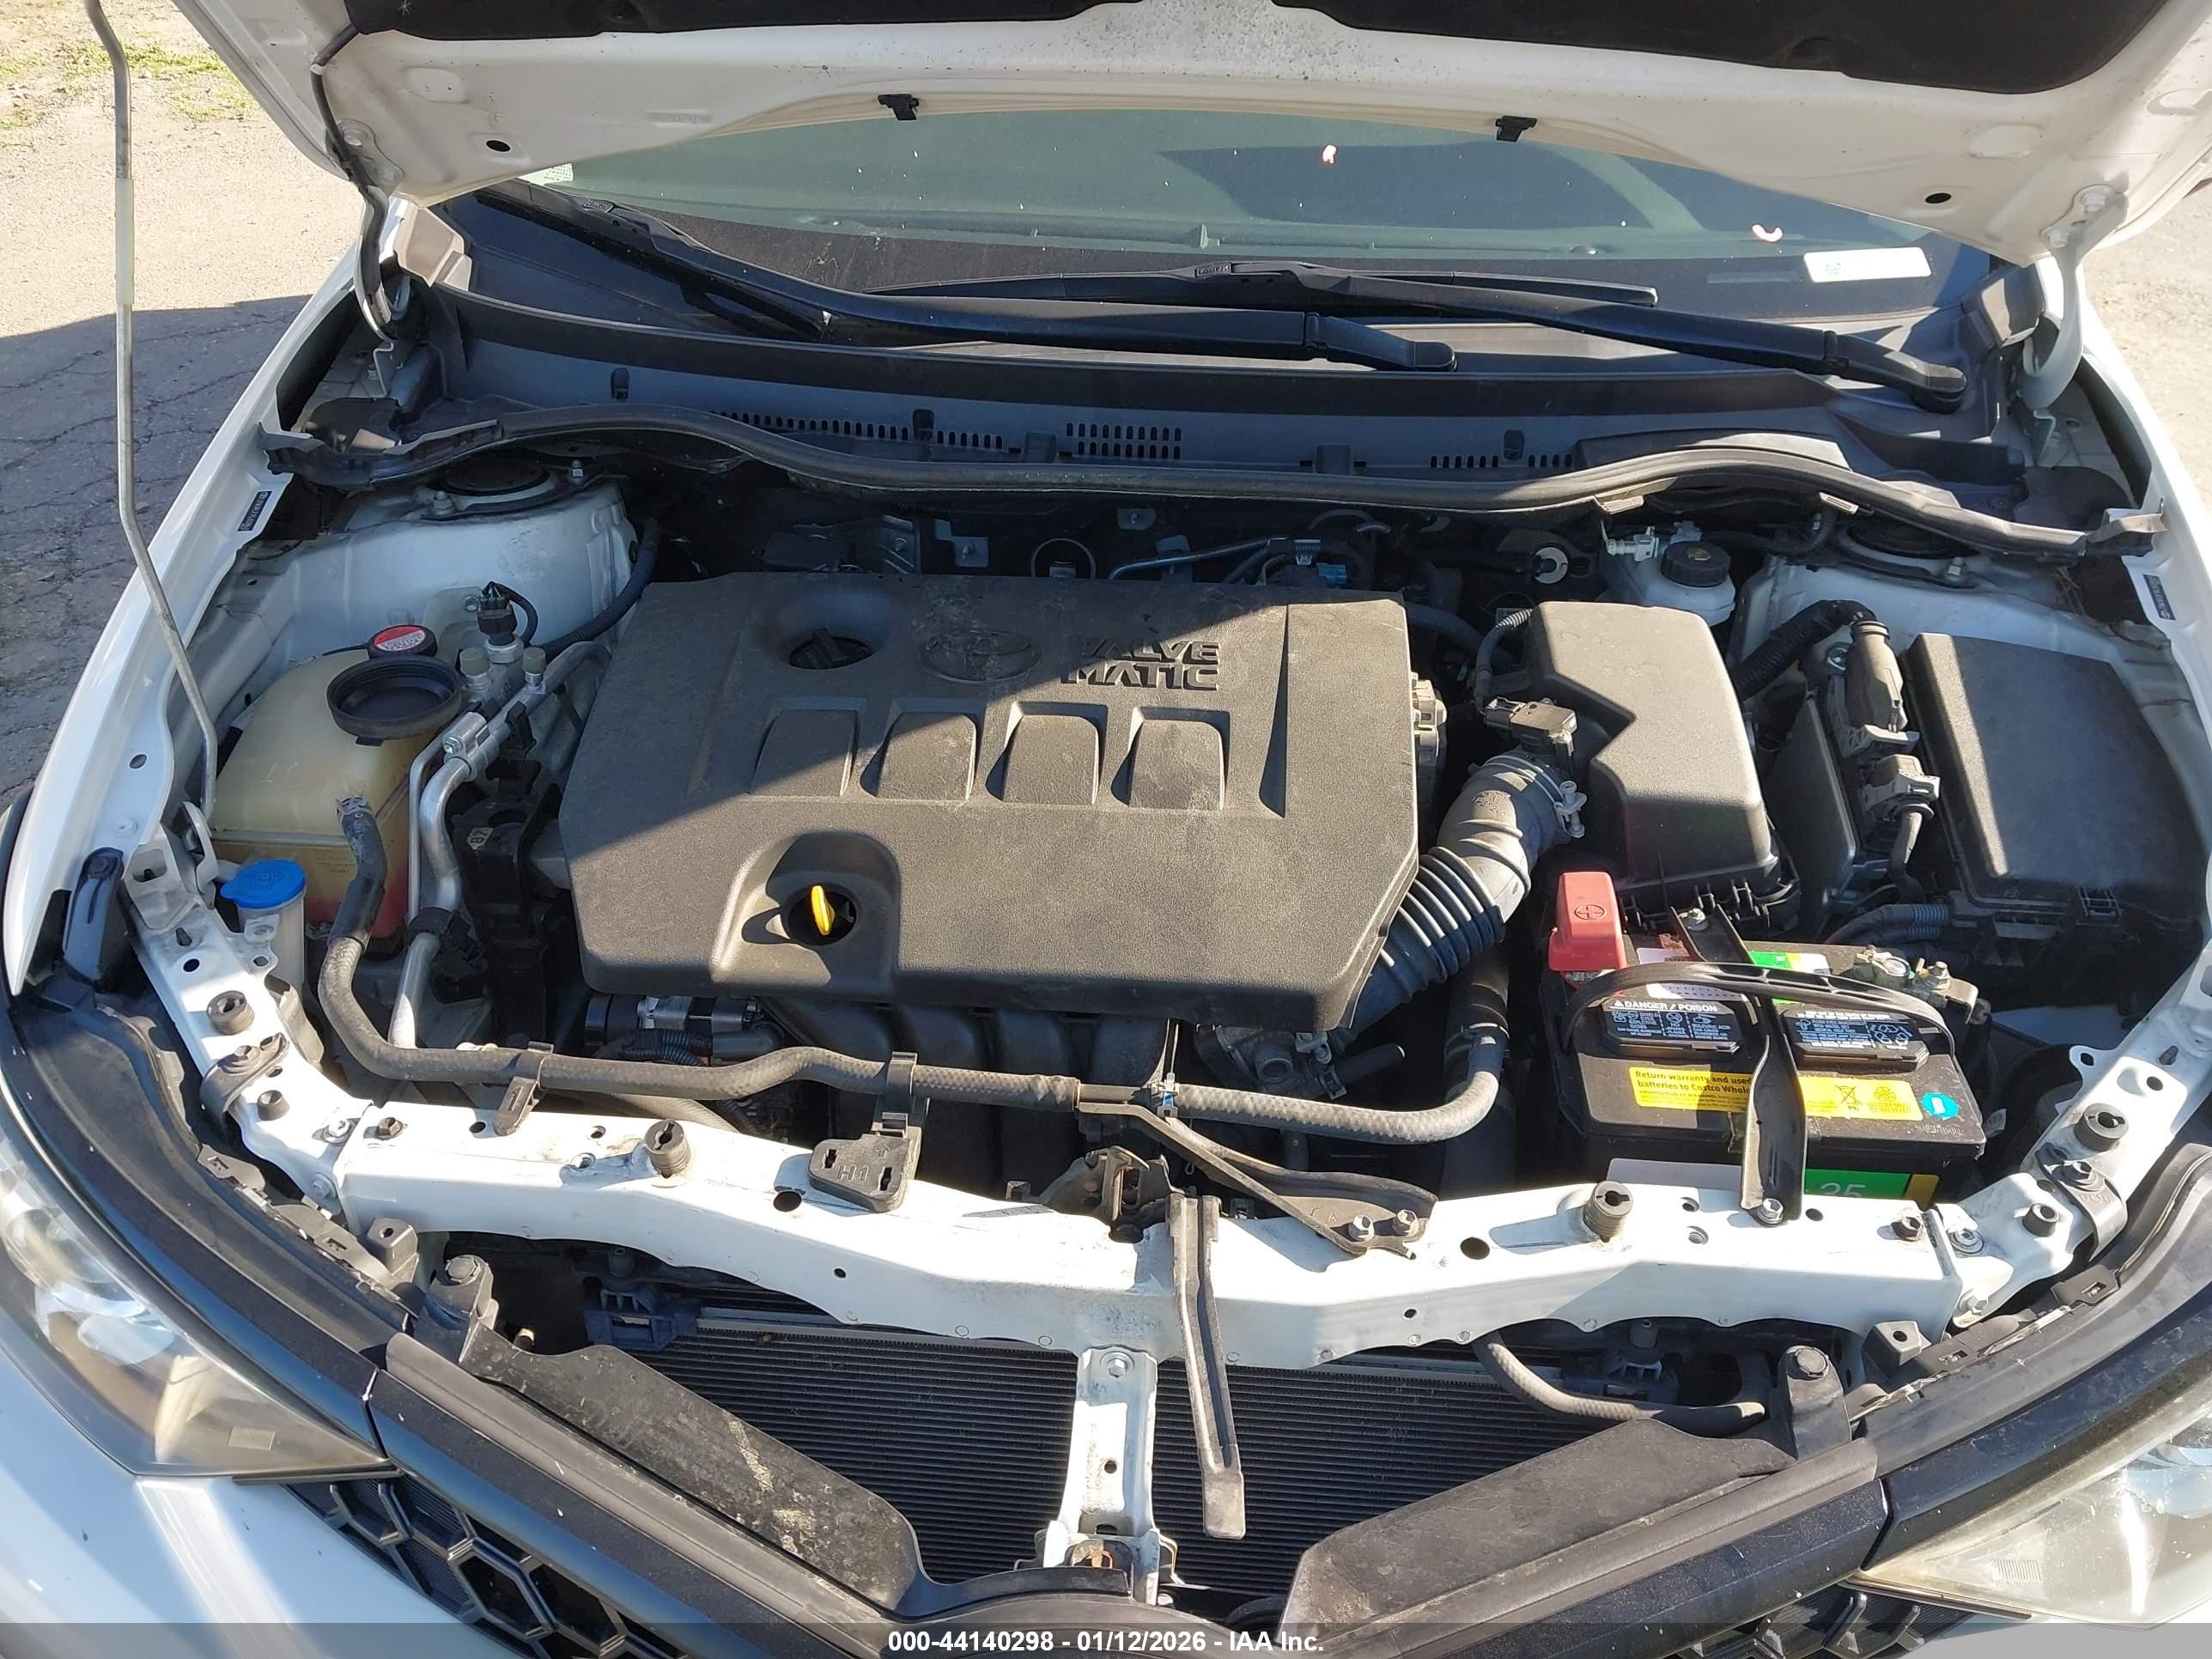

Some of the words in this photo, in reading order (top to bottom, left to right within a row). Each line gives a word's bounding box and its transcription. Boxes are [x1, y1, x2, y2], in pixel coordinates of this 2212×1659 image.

[1084, 638, 1221, 665] VALVE
[1061, 660, 1220, 690] MATIC
[1624, 1000, 1668, 1010] DANGER
[1677, 1004, 1717, 1012] POISON
[1636, 1071, 1667, 1079] Return
[1668, 1074, 1710, 1084] warranty
[1638, 1080, 1679, 1090] batteries
[1680, 1082, 1689, 1091] to
[1691, 1084, 1721, 1092] Costco
[837, 1164, 870, 1182] H1
